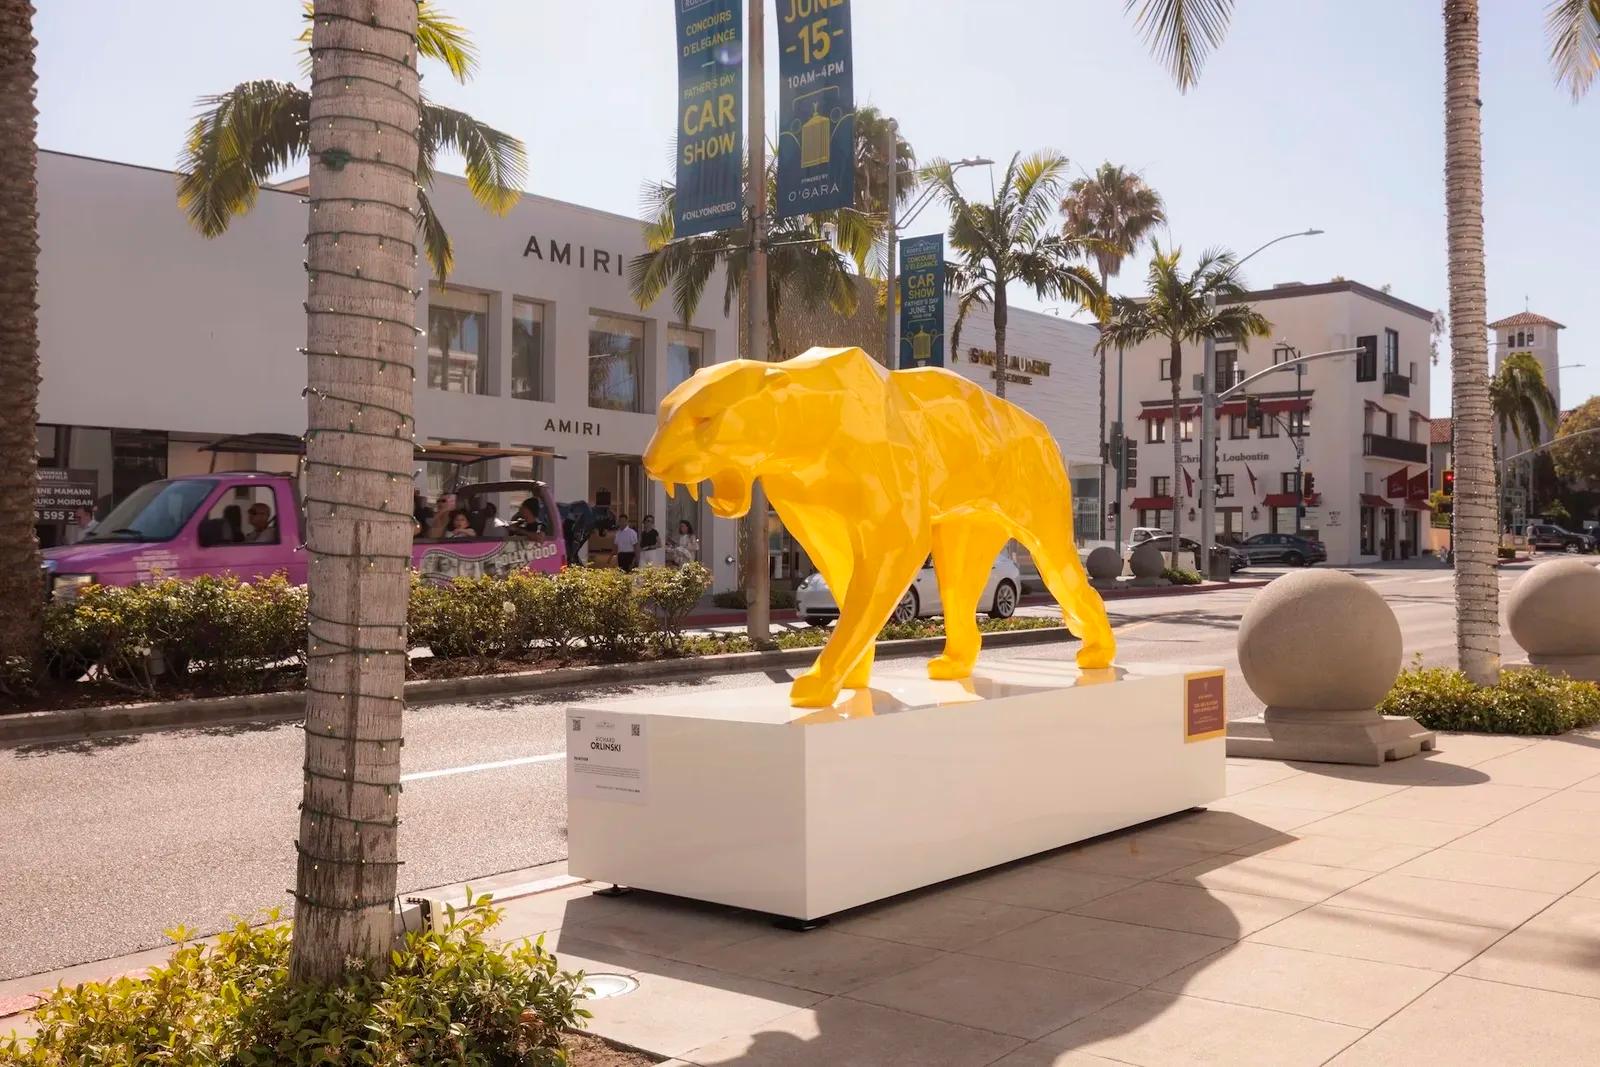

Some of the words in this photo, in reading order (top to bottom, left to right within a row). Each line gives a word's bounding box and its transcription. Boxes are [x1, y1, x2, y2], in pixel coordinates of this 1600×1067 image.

[685, 10, 732, 37] CONCOURS
[683, 28, 736, 57] D'ELEGANCE
[720, 72, 736, 88] DAY
[683, 93, 736, 136] CAR
[683, 131, 736, 166] SHOW
[788, 183, 840, 202] O'GARA
[681, 201, 737, 221] #ONLYONRODEO
[523, 235, 623, 276] AMIRI
[907, 273, 935, 290] CAR
[908, 287, 936, 300] SHOW
[908, 306, 927, 315] JUNE
[928, 304, 936, 313] 15
[544, 418, 600, 437] AMIRI
[54, 487, 91, 496] MAMANN
[590, 741, 621, 752] ORLINSKI
